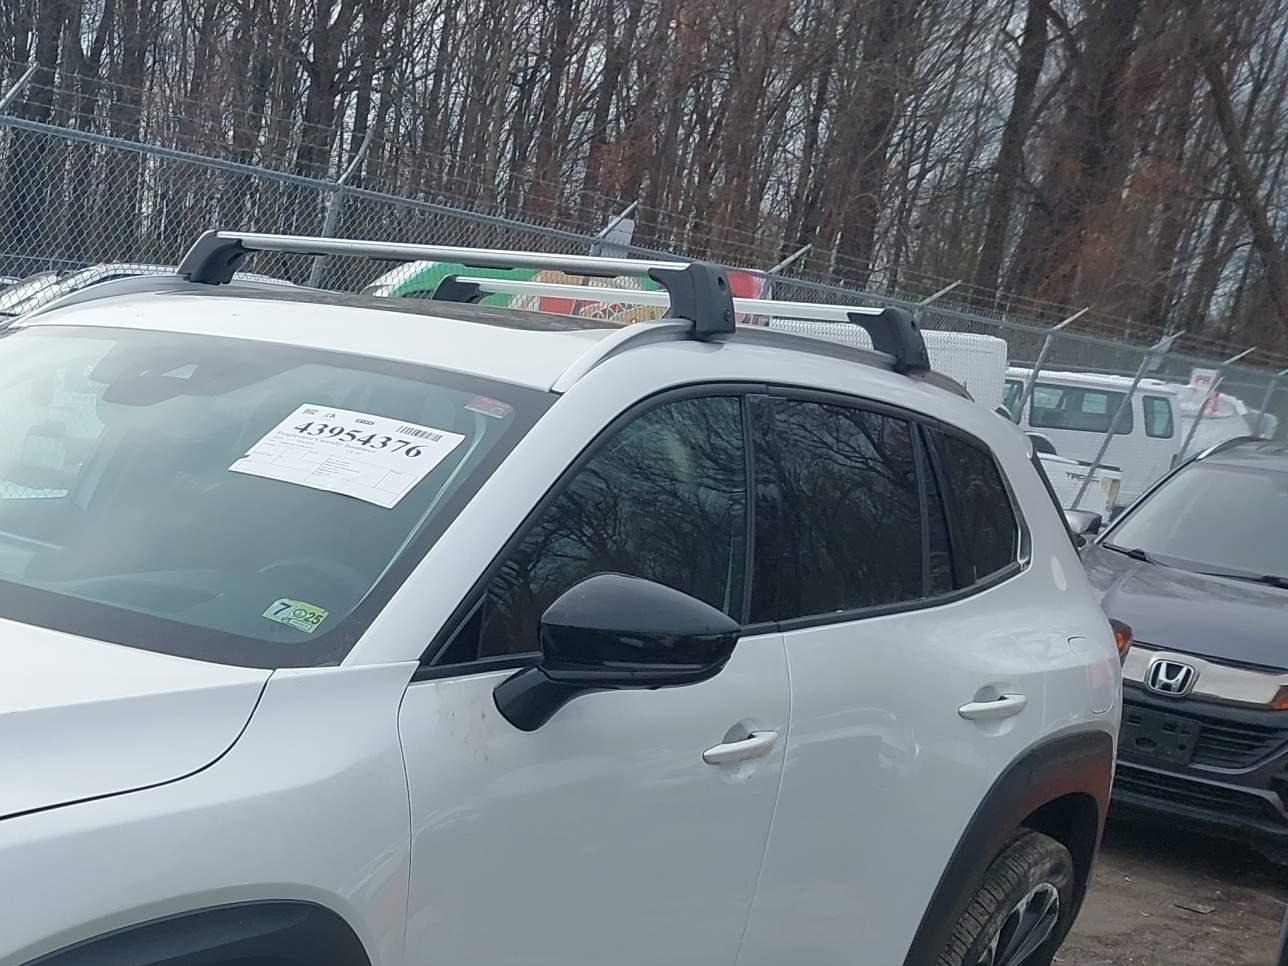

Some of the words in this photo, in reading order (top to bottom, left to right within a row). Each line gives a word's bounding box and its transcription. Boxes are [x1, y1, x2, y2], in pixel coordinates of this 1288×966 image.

[294, 421, 429, 458] 43954376
[273, 602, 292, 616] 7
[303, 611, 324, 625] 25
